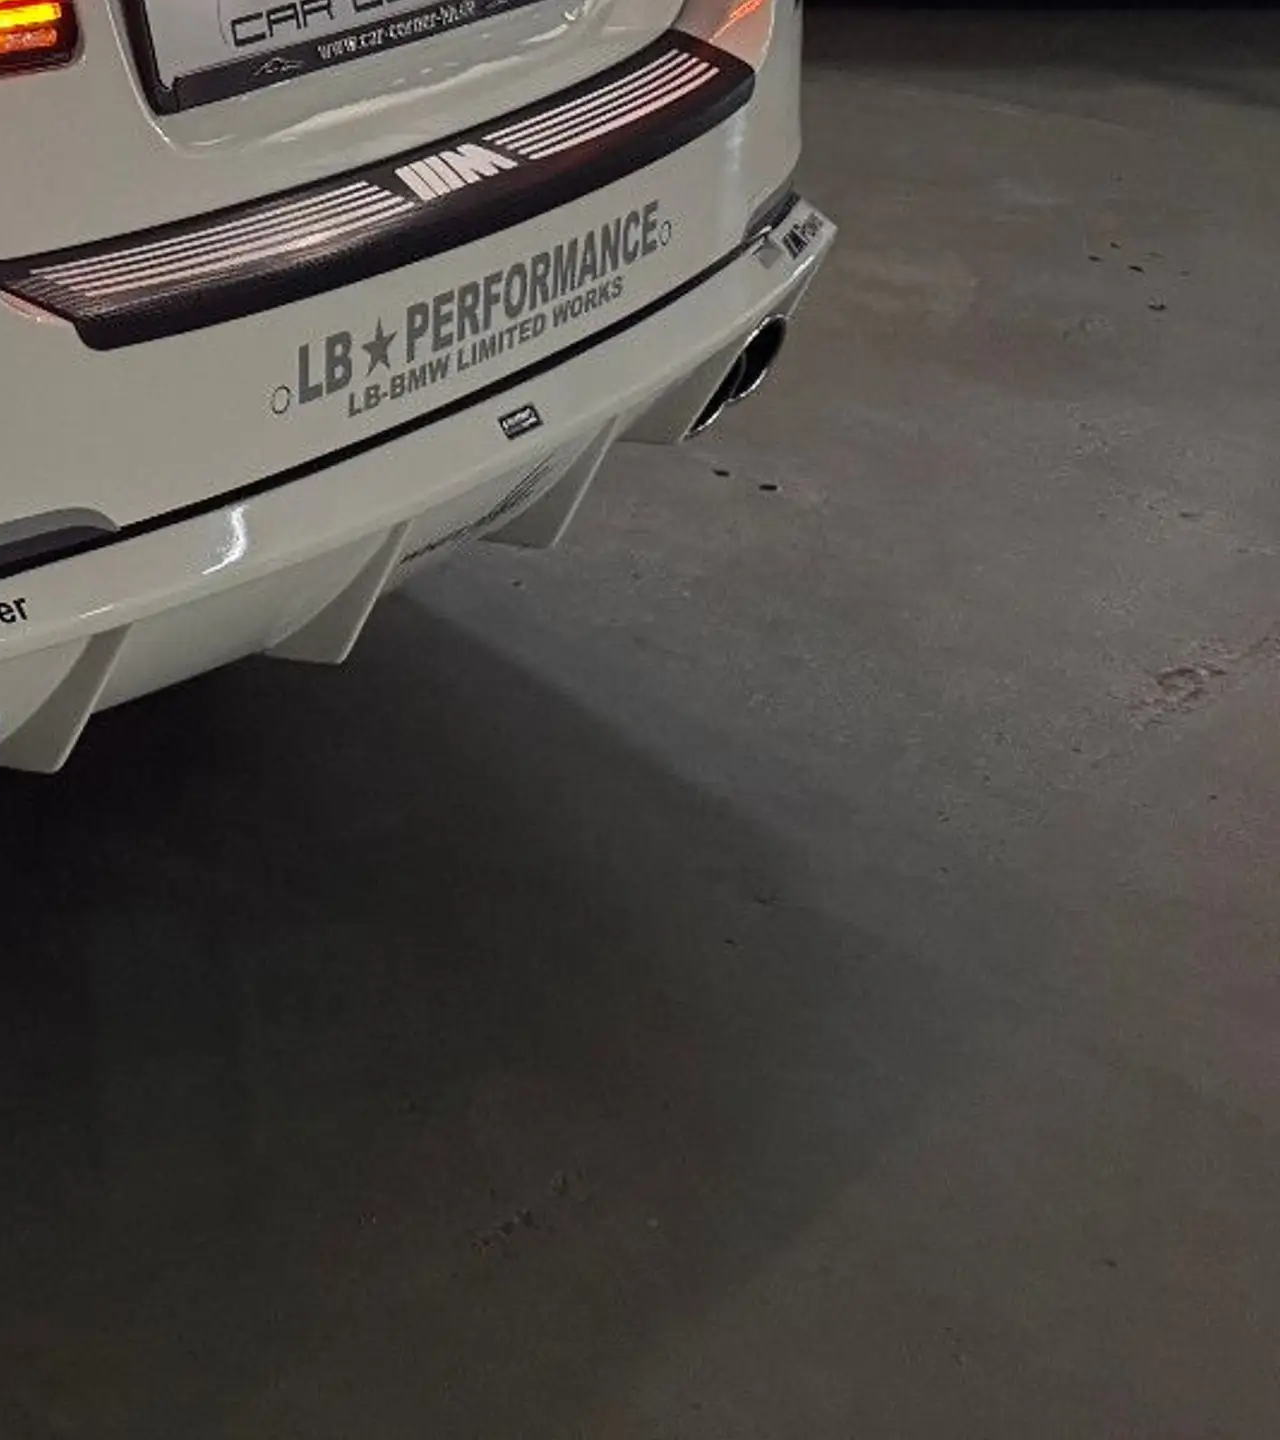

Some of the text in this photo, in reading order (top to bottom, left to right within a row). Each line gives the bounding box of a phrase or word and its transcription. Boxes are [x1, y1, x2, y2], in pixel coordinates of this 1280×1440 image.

[348, 276, 623, 418] LB-BMW LIMITED WORKS
[406, 199, 659, 363] PERFORMANCE
